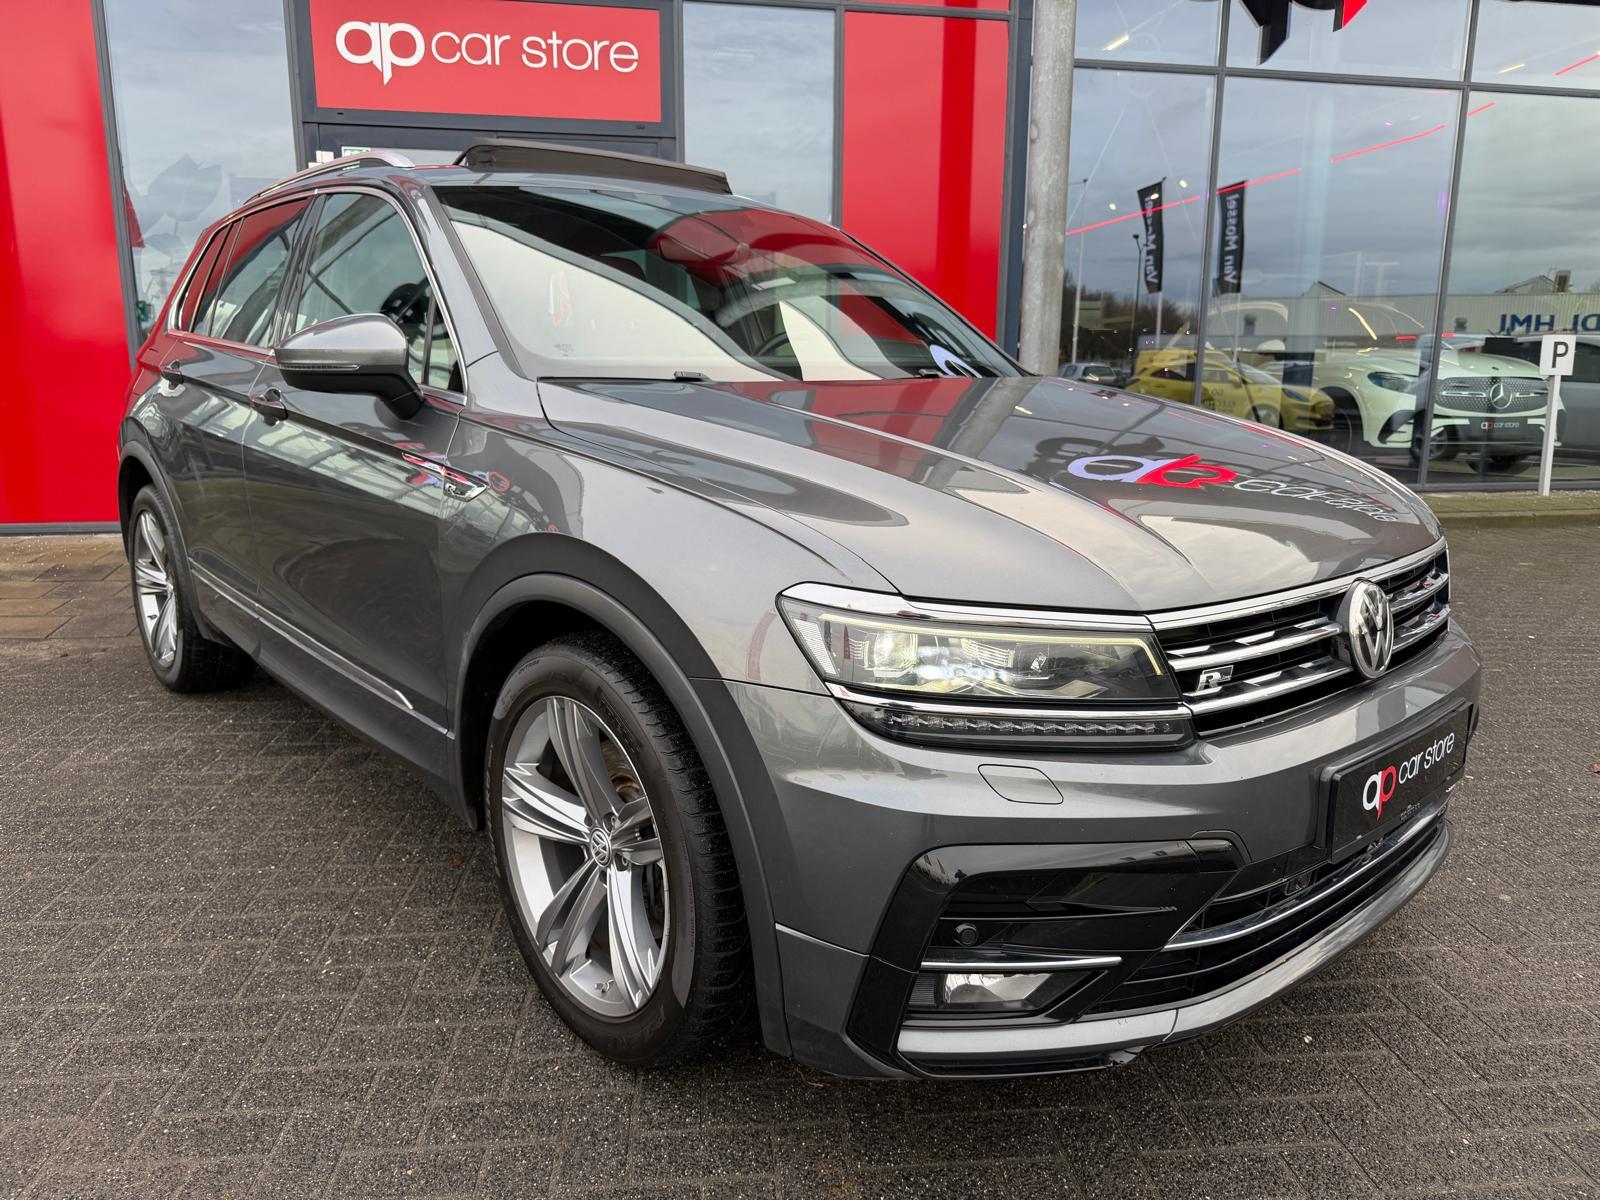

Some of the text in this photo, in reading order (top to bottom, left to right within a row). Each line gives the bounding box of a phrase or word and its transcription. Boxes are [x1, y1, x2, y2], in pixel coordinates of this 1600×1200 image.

[335, 20, 640, 86] ap car store
[1551, 341, 1569, 369] P
[1362, 765, 1397, 821] ap
[1398, 752, 1424, 784] car
[1424, 732, 1455, 769] store
